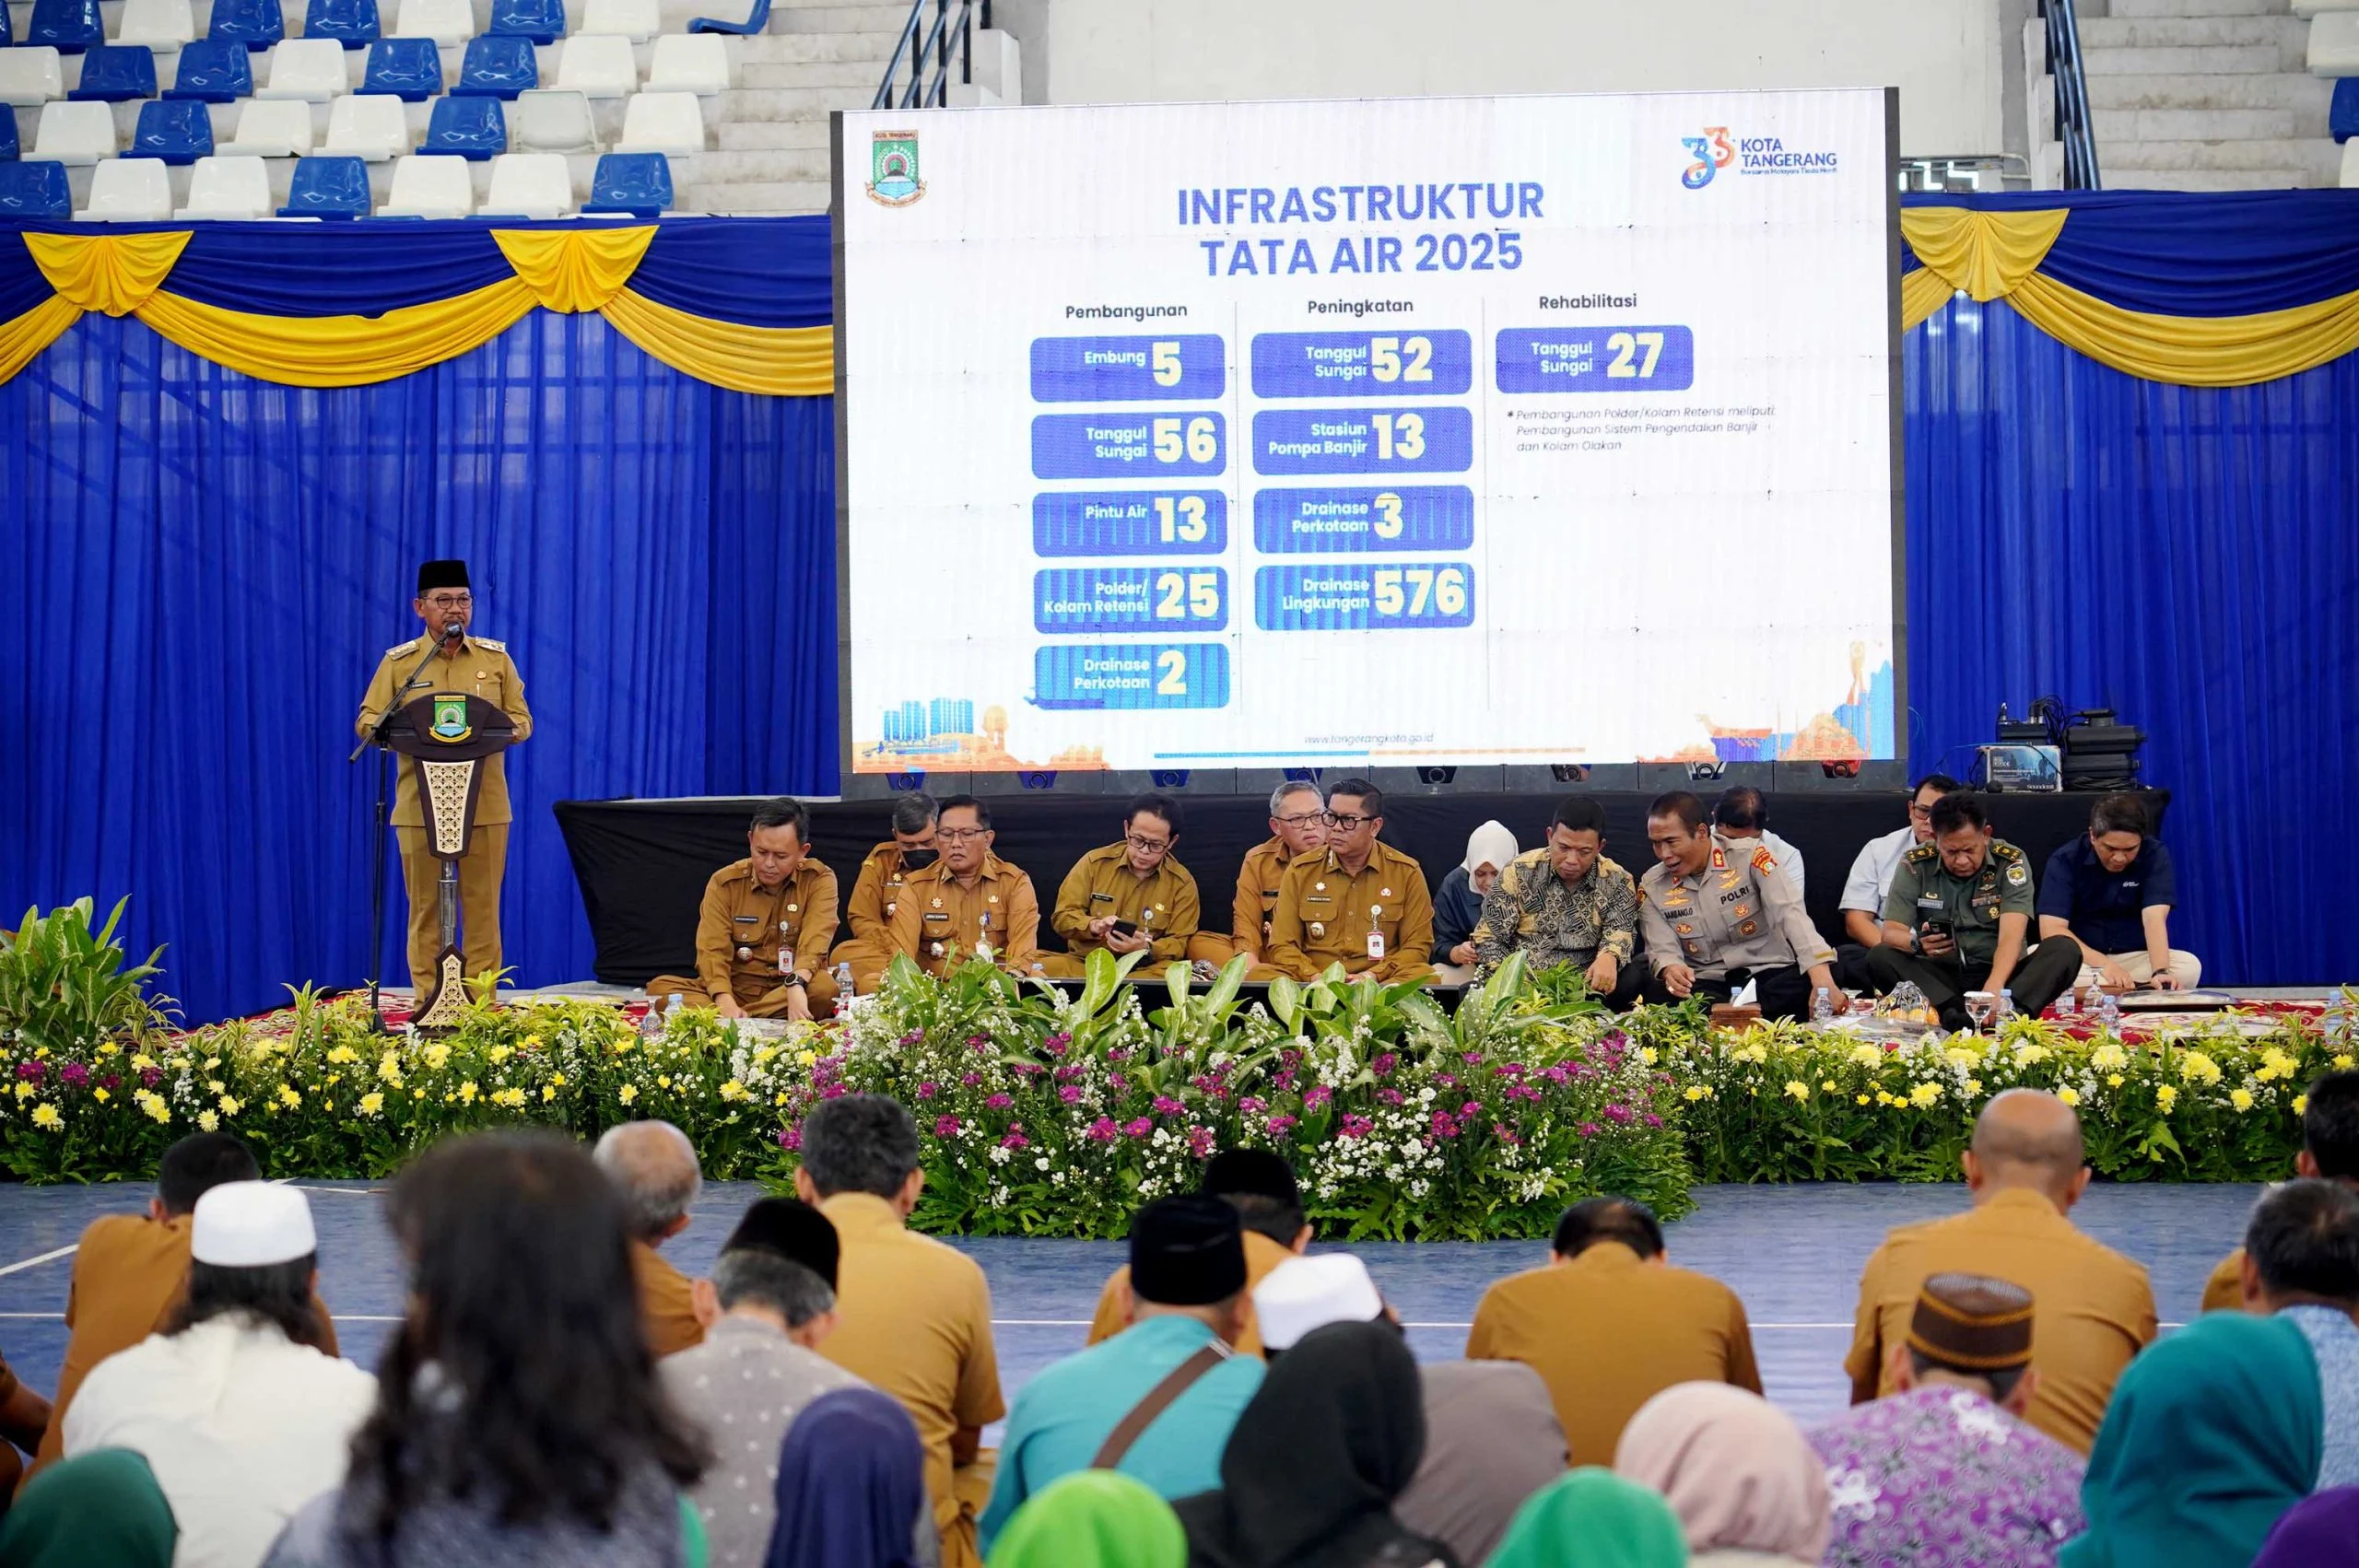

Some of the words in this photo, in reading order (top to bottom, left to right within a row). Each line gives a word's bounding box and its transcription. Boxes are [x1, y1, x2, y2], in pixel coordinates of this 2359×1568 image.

[1741, 137, 1783, 153] KOTA
[1742, 152, 1837, 168] TANGERANG
[1178, 181, 1544, 225] INFRASTRUKTUR
[1200, 239, 1319, 276] TATA
[1330, 237, 1402, 274] AIR
[1415, 232, 1523, 272] 2025
[1308, 298, 1414, 317] Peningkatan
[1539, 293, 1637, 310] Rehabilitasi
[1065, 304, 1188, 322] Pembangunan
[1305, 345, 1367, 363] Tanggul
[1531, 340, 1593, 358] Tanggul
[1606, 332, 1665, 378] 27
[1084, 350, 1146, 367] Embung
[1152, 341, 1183, 387] 5
[1371, 335, 1434, 383] 52
[1540, 357, 1593, 377] Sungai
[1315, 362, 1367, 380] Sungai
[1516, 409, 1602, 423] Pembangunan
[1684, 406, 1725, 417] Retensi
[1086, 426, 1147, 444] Tanggul
[1310, 421, 1367, 437] Stasiun
[1372, 412, 1426, 461] 13
[1516, 425, 1602, 439] Pembangunan
[1604, 423, 1642, 435] Sistem
[1645, 422, 1723, 436] Pengendalian
[1726, 420, 1758, 435] Banjir
[1153, 415, 1219, 464] 56
[1517, 441, 1540, 451] dan
[1543, 440, 1579, 451] Kolam
[1095, 443, 1148, 462] Sungai
[1268, 441, 1321, 459] Pompa
[1324, 439, 1368, 457] Banjir
[1085, 504, 1123, 520] Pintu
[1126, 504, 1148, 518] Air
[1301, 500, 1369, 516] Drainase
[1373, 491, 1404, 540] 3
[1154, 495, 1209, 544] 13
[1292, 518, 1369, 533] Perkotaan
[1095, 579, 1148, 597] Polder/
[1302, 578, 1370, 592] Drainase
[1374, 568, 1466, 615] 576
[1156, 571, 1221, 619] 25
[1282, 594, 1370, 614] Lingkungan
[1043, 600, 1092, 614] Kolam
[1095, 598, 1150, 614] Retensi
[1084, 657, 1151, 673] Drainase
[1156, 649, 1188, 696] 2
[1074, 674, 1151, 690] Perkotaan
[1720, 885, 1750, 905] POLRI
